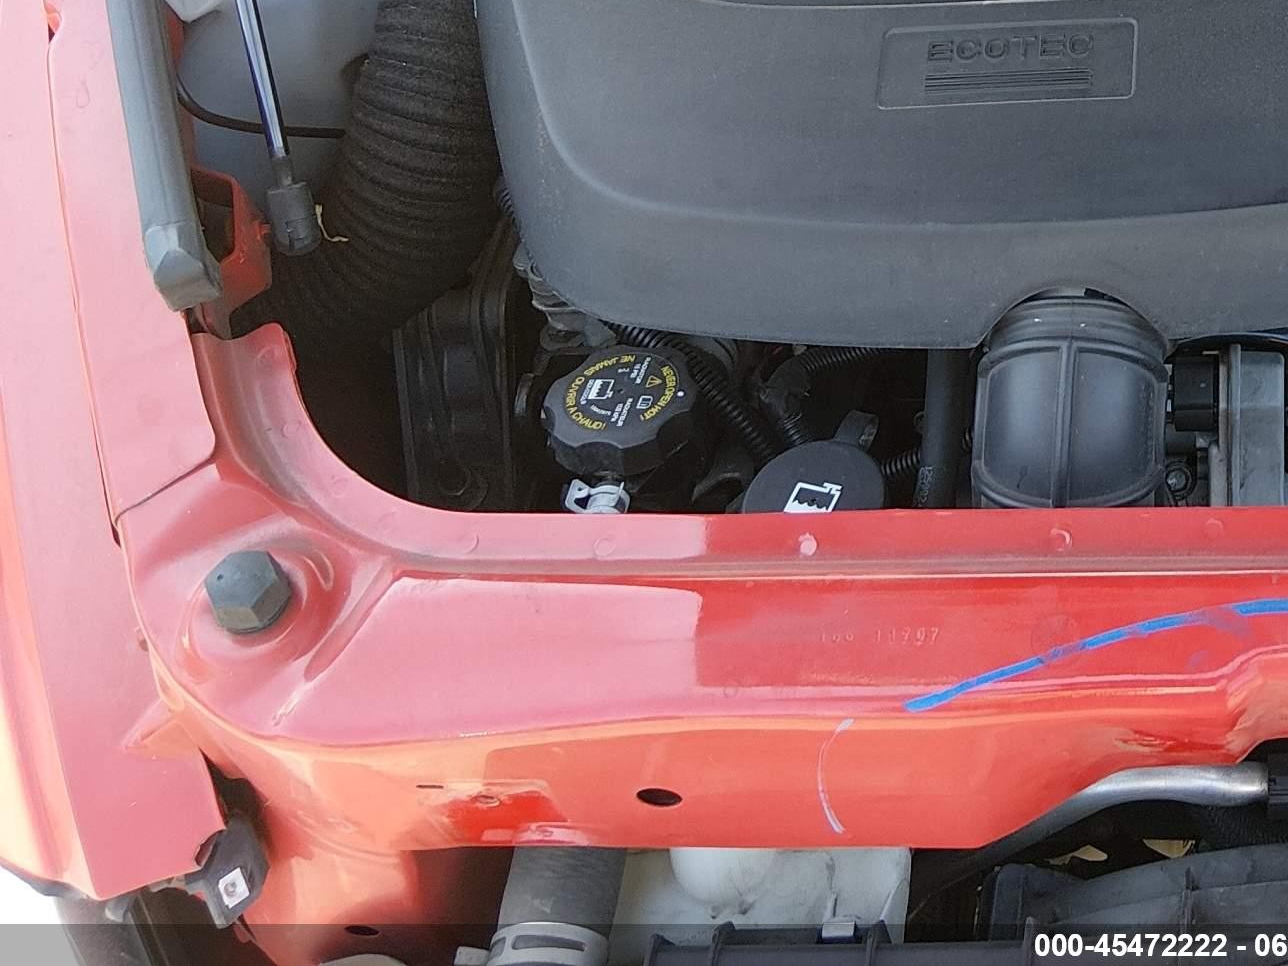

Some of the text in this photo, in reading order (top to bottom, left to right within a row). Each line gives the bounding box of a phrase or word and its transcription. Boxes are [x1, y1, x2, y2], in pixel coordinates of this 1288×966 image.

[927, 34, 1094, 63] ECOTEC
[584, 357, 619, 376] JAMAIS
[620, 355, 636, 364] NE
[661, 365, 676, 387] NEVER
[566, 376, 585, 406] OUVRIR
[659, 387, 676, 406] OPEN
